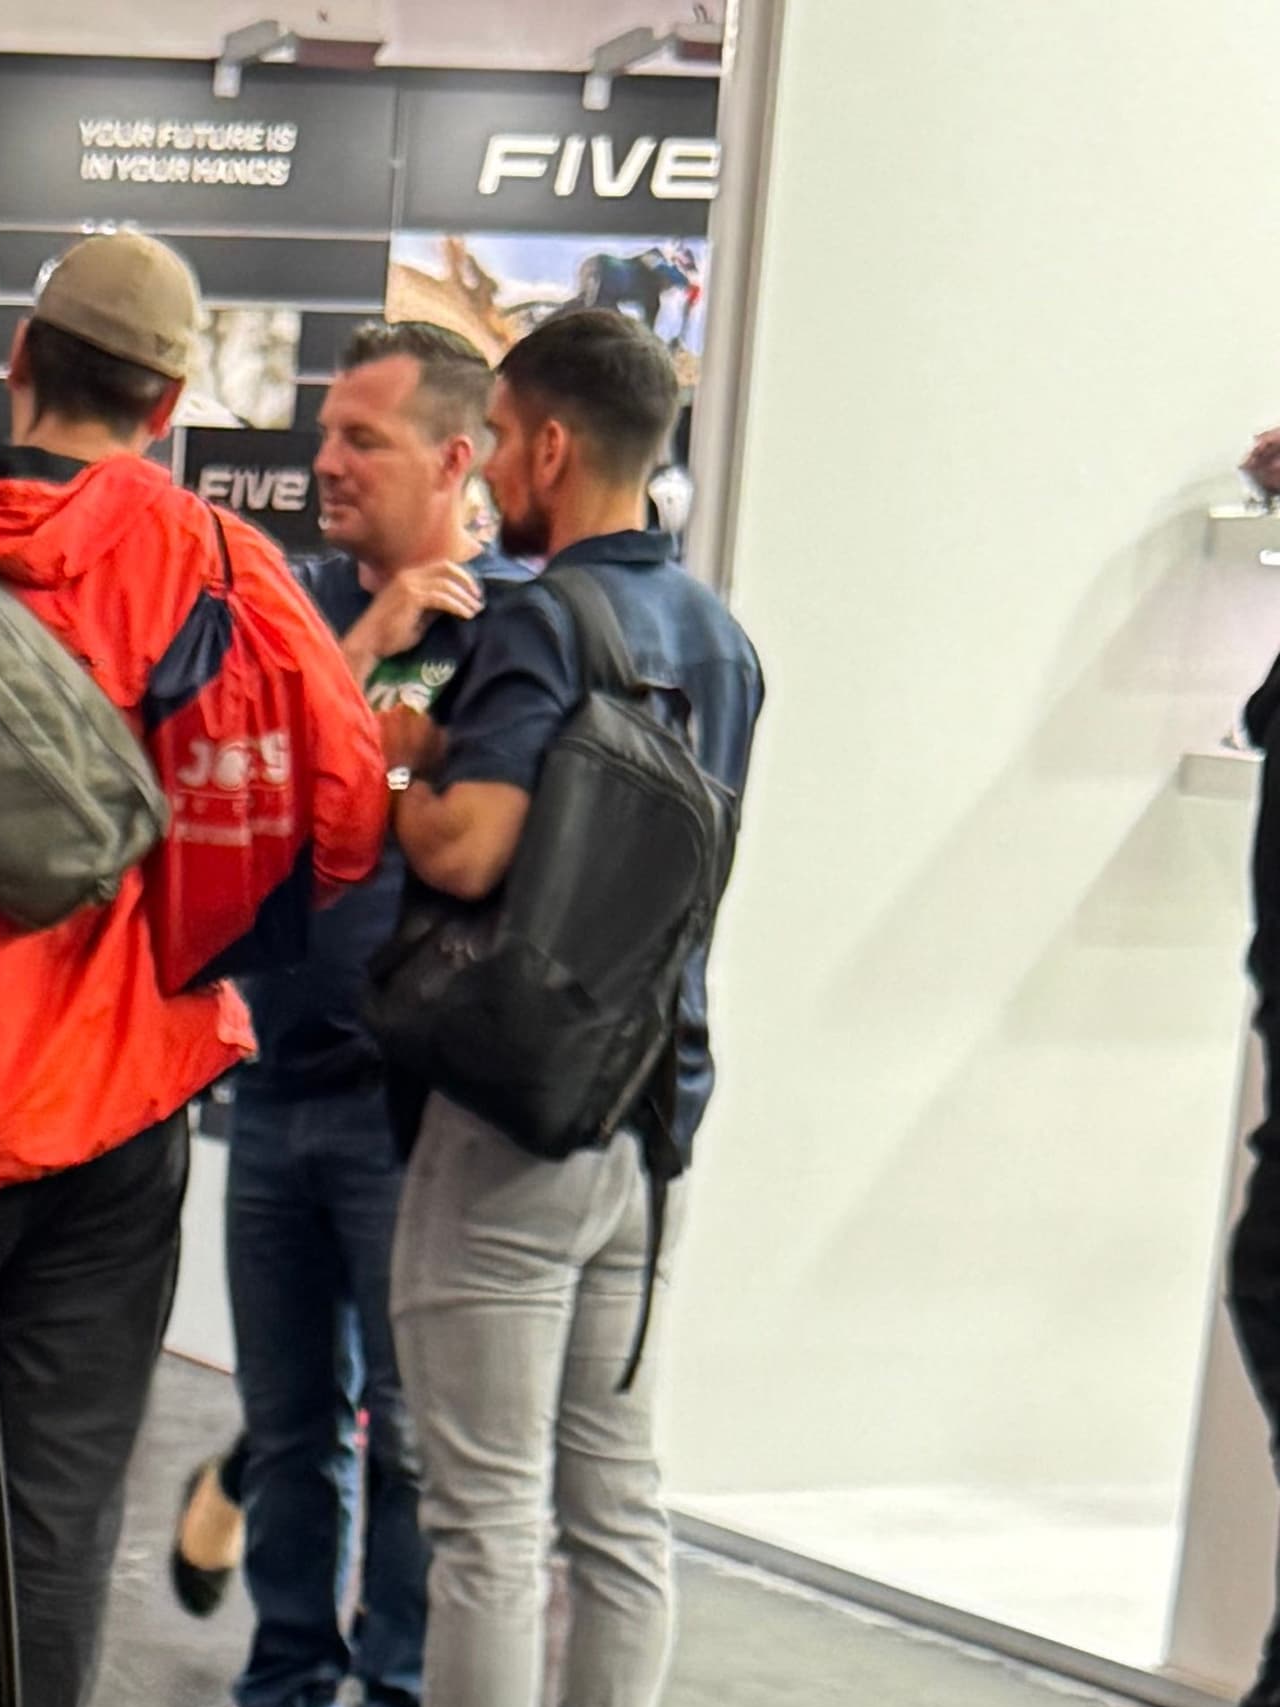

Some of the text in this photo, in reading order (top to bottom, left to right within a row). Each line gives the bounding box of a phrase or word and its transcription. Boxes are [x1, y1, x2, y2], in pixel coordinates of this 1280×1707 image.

[79, 119, 298, 152] YOUR FUTURE IS
[80, 154, 290, 187] IN YOUR HANDS
[478, 133, 722, 199] FIVE
[197, 465, 310, 511] FIVE
